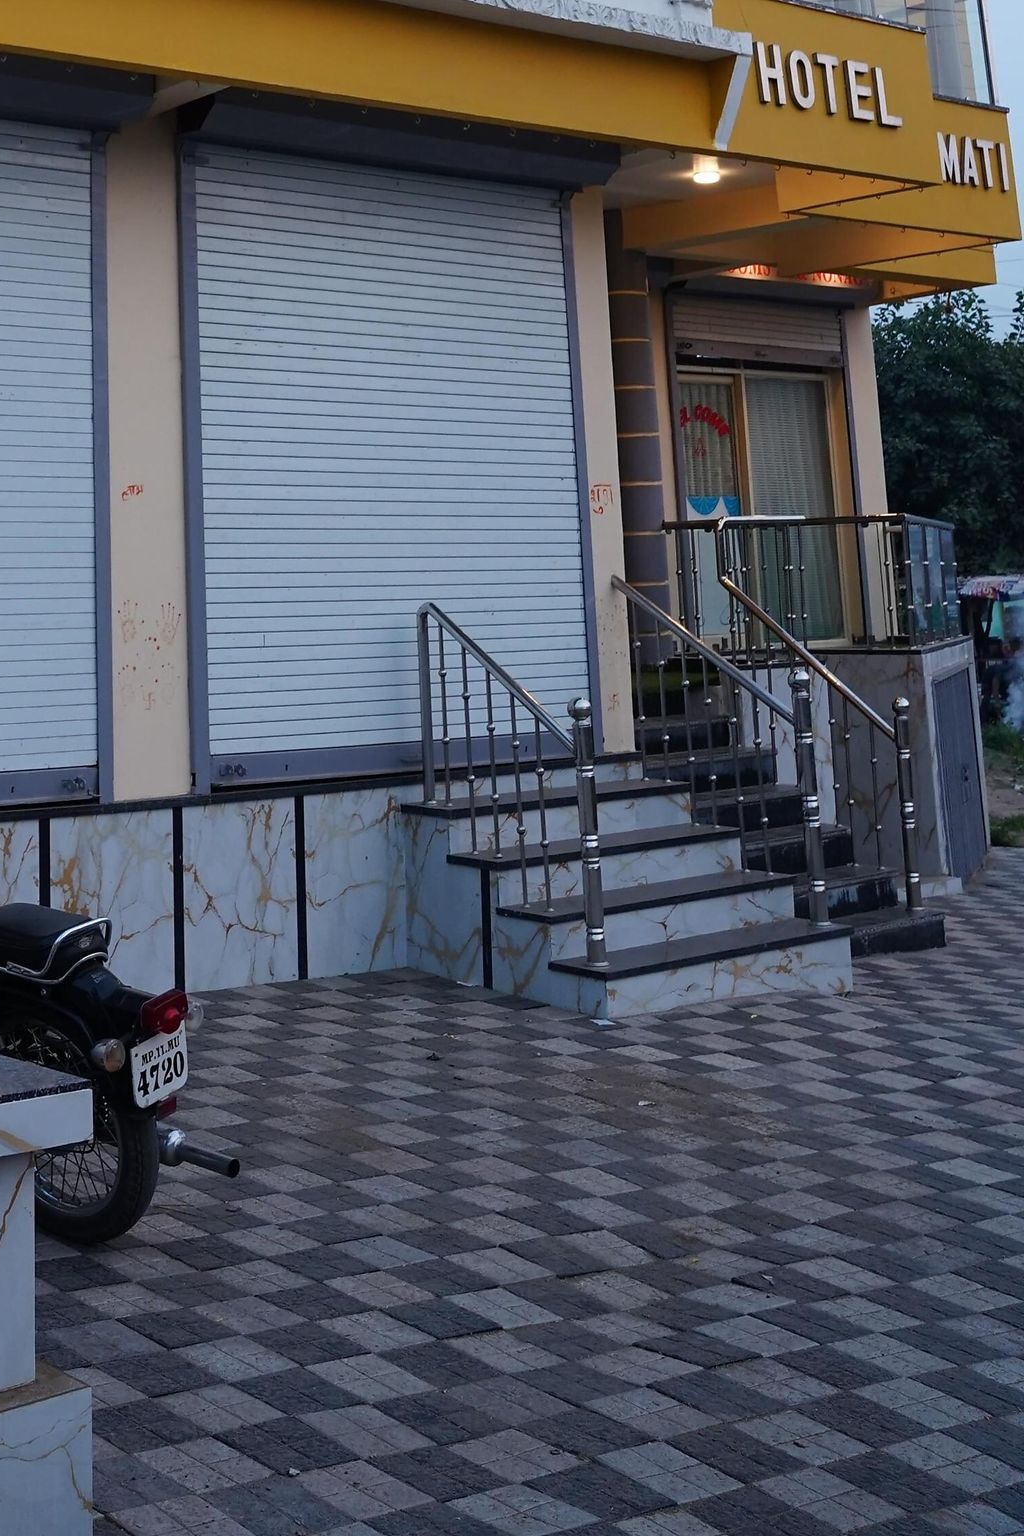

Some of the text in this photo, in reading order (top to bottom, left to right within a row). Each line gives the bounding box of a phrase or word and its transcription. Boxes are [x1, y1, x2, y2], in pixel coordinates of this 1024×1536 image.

[753, 41, 902, 128] HOTEL
[936, 132, 1010, 192] MATI
[137, 1050, 185, 1097] 4720
